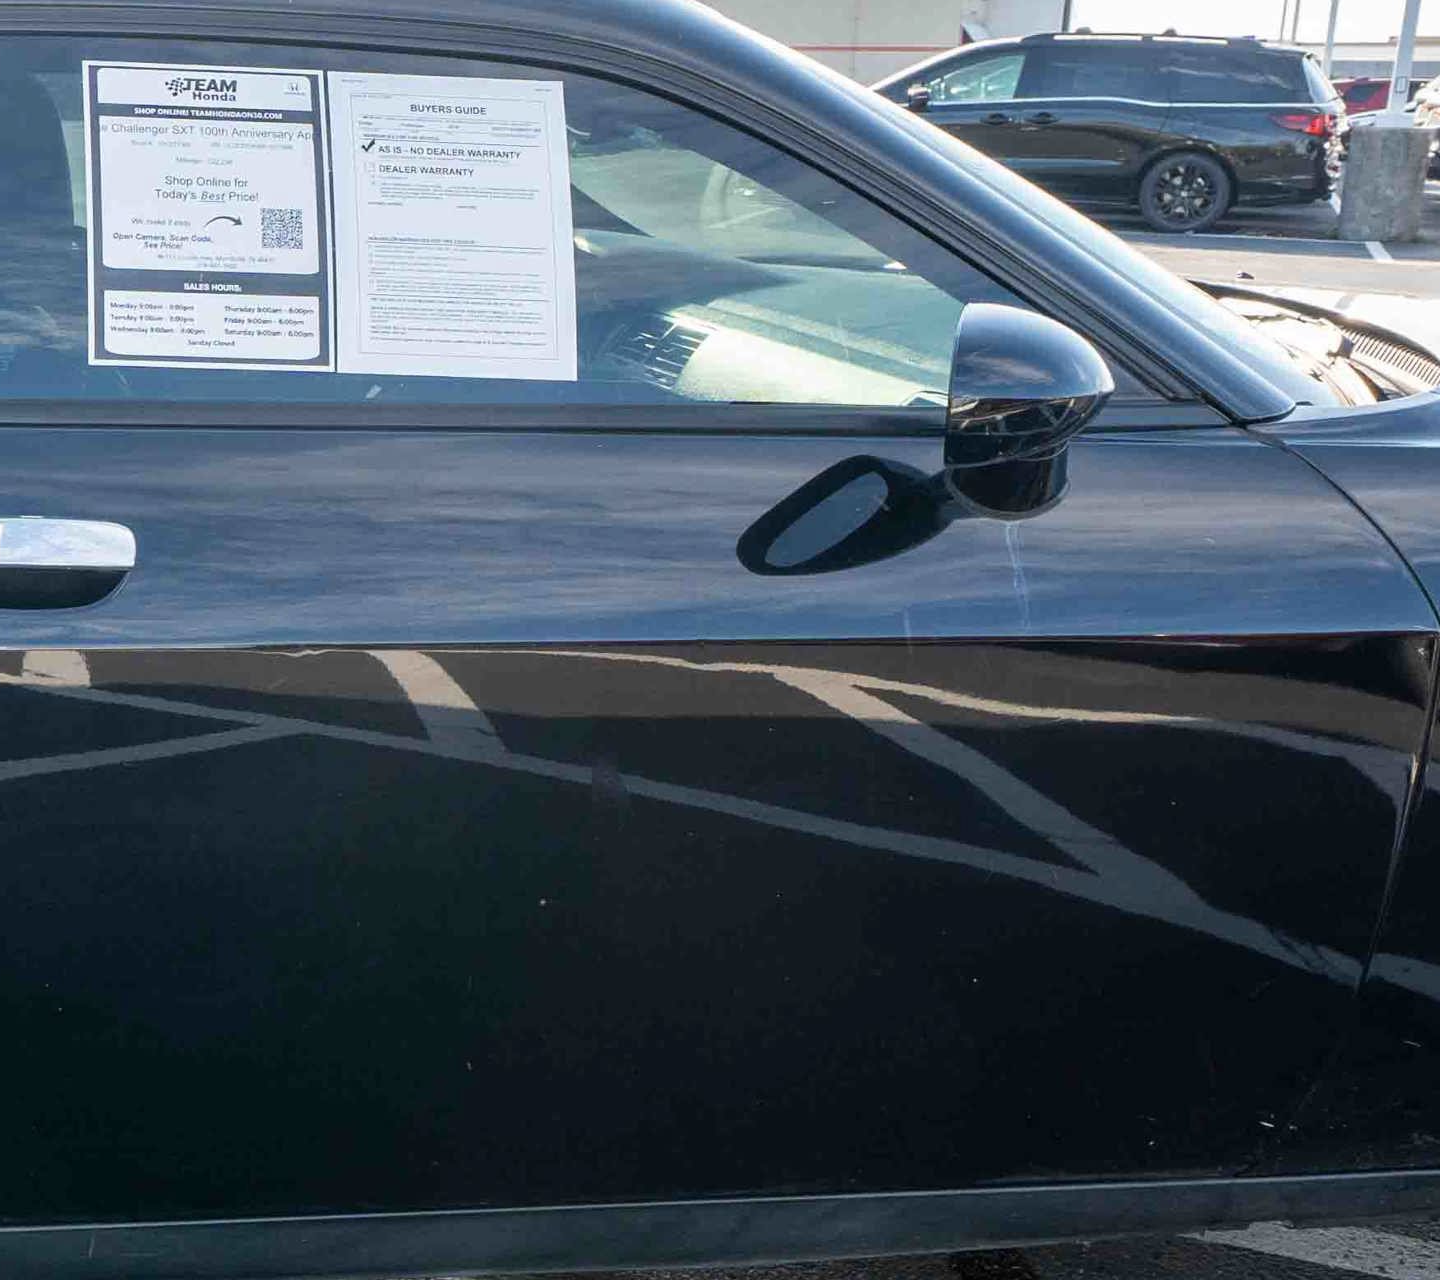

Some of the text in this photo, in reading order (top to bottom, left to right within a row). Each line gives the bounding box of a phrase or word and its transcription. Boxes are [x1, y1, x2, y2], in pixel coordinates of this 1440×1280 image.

[184, 78, 238, 93] TEAM
[192, 92, 237, 102] Honda
[134, 107, 156, 116] SHOP
[410, 104, 487, 115] BUYERS GUIDE
[111, 123, 168, 137] Challenger
[171, 125, 194, 135] SXT
[199, 126, 229, 137] 100th
[232, 127, 294, 142] Anniversary
[378, 146, 391, 154] AS
[410, 147, 424, 155] NO
[427, 148, 465, 157] DEALER
[467, 149, 522, 159] WARRANTY
[379, 165, 474, 177] DEALER WARRANTY
[165, 175, 249, 188] Shop Online for
[154, 189, 259, 203] Today's Best Price!
[113, 232, 133, 242] Open
[170, 234, 189, 242] Scan
[144, 241, 158, 249] See
[184, 282, 210, 291] SALES
[110, 302, 137, 310] Monday
[224, 305, 255, 313] Thursday
[224, 317, 245, 325] Friday
[110, 326, 148, 334] Wednesday
[224, 328, 255, 336] Saturday
[187, 339, 211, 347] Sunday
